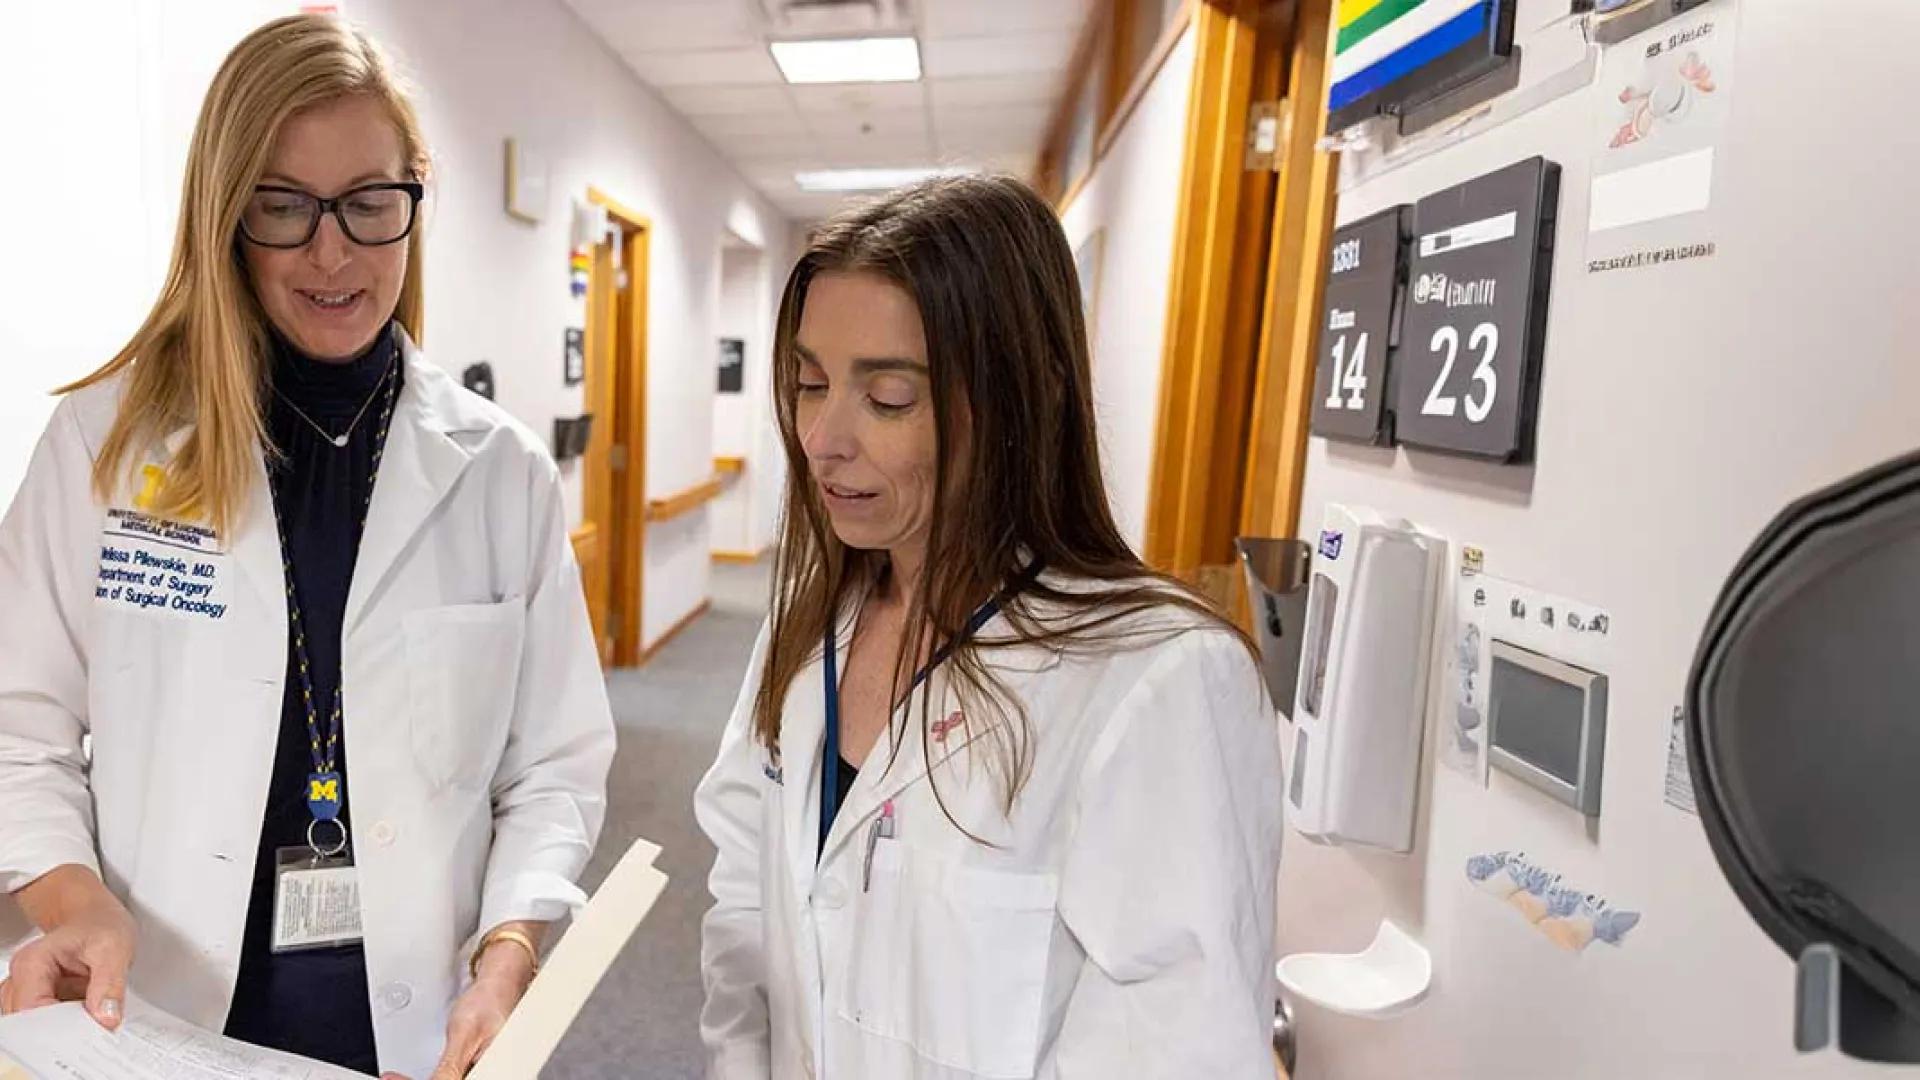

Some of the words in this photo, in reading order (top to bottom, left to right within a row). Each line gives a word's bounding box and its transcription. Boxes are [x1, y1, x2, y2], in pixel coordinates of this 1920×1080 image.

[1325, 333, 1369, 410] 14
[1420, 322, 1498, 422] 23
[149, 573, 165, 587] of
[167, 575, 213, 598] Surgery
[111, 586, 122, 600] of
[125, 587, 169, 608] Surgical
[171, 595, 227, 619] Oncology
[309, 779, 337, 801] M
